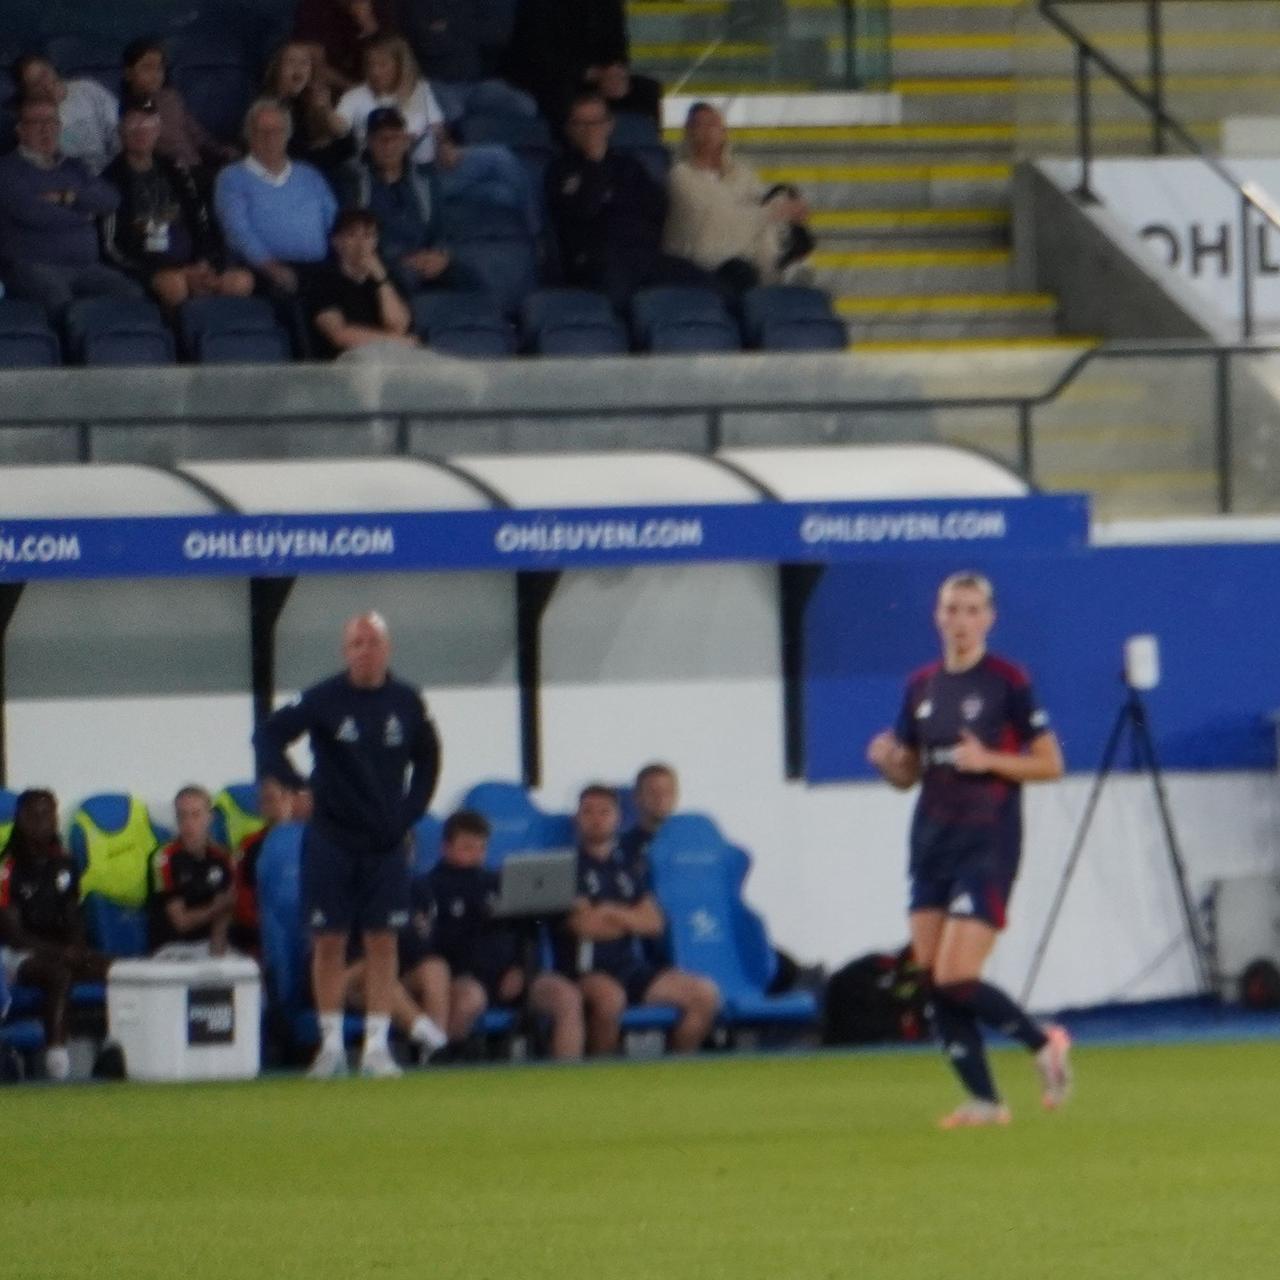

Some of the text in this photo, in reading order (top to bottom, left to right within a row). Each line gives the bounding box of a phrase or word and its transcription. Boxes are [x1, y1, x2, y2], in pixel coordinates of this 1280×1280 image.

[184, 526, 395, 559] OHLEUVEN.COM
[496, 519, 701, 552] OHLEUVEN.COM
[801, 511, 1006, 543] OHLEUVEN.COM
